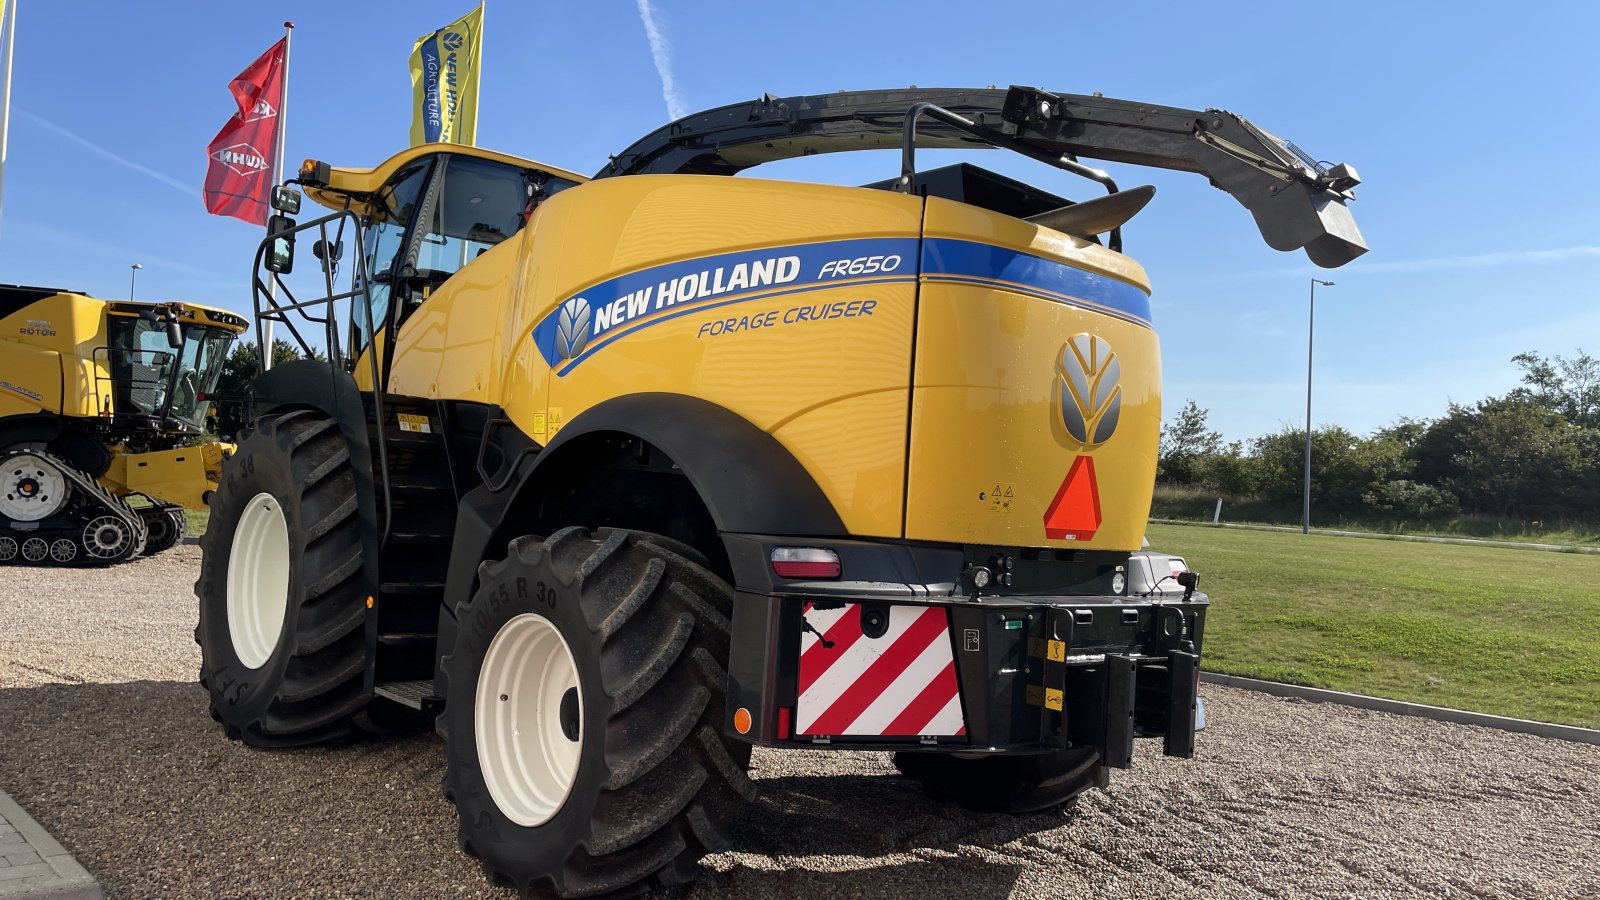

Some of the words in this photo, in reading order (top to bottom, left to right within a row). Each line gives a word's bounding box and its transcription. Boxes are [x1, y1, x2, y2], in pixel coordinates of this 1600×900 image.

[817, 254, 902, 280] FR650
[593, 286, 653, 336] NEW
[655, 255, 801, 310] HOLLAND
[20, 328, 57, 336] ROTOR
[697, 310, 779, 339] FORAGE
[783, 300, 877, 325] CRUISER
[240, 453, 254, 479] 38
[516, 577, 528, 598] R
[536, 581, 557, 610] 30
